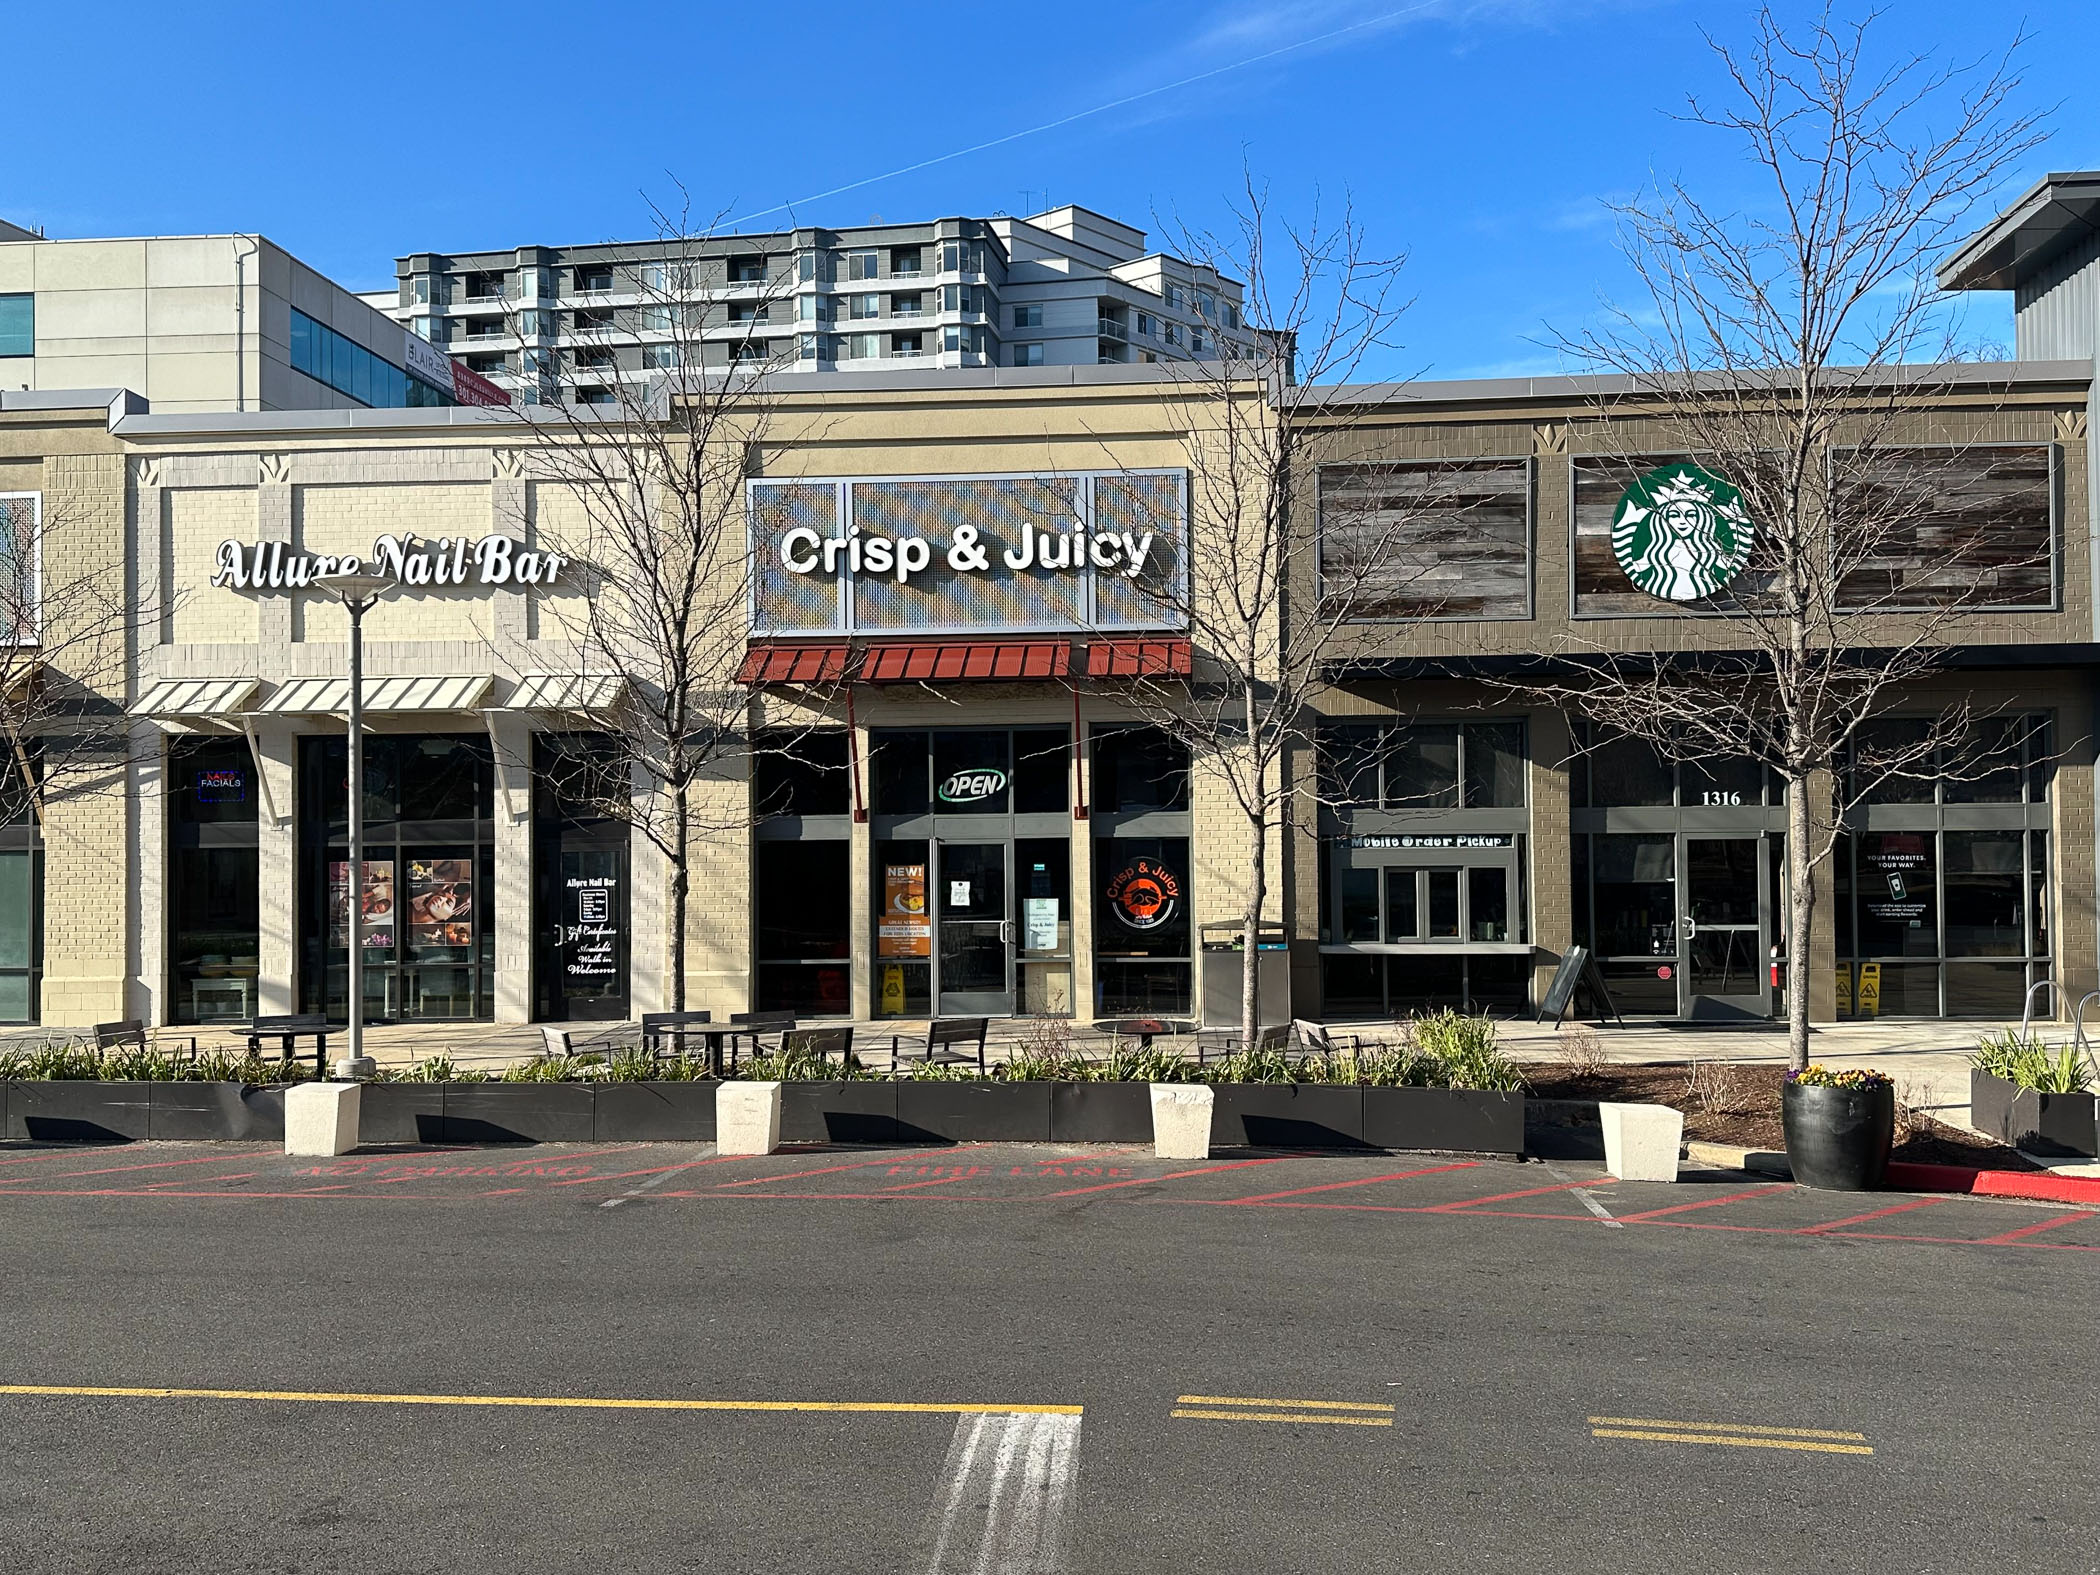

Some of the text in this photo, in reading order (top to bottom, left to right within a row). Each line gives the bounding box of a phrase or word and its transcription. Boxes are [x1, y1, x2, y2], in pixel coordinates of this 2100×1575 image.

[408, 343, 435, 373] BLAIR
[211, 532, 568, 588] Allure Nail Bar
[780, 520, 1153, 583] Crisp & Juicy
[943, 775, 998, 796] OPEN
[1702, 791, 1741, 806] 1316
[1456, 835, 1502, 848] Pickup
[888, 867, 922, 877] NEW!
[1106, 861, 1179, 898] Crisp & Juicy
[567, 964, 617, 975] Welcome
[1009, 1166, 1135, 1178] LANE
